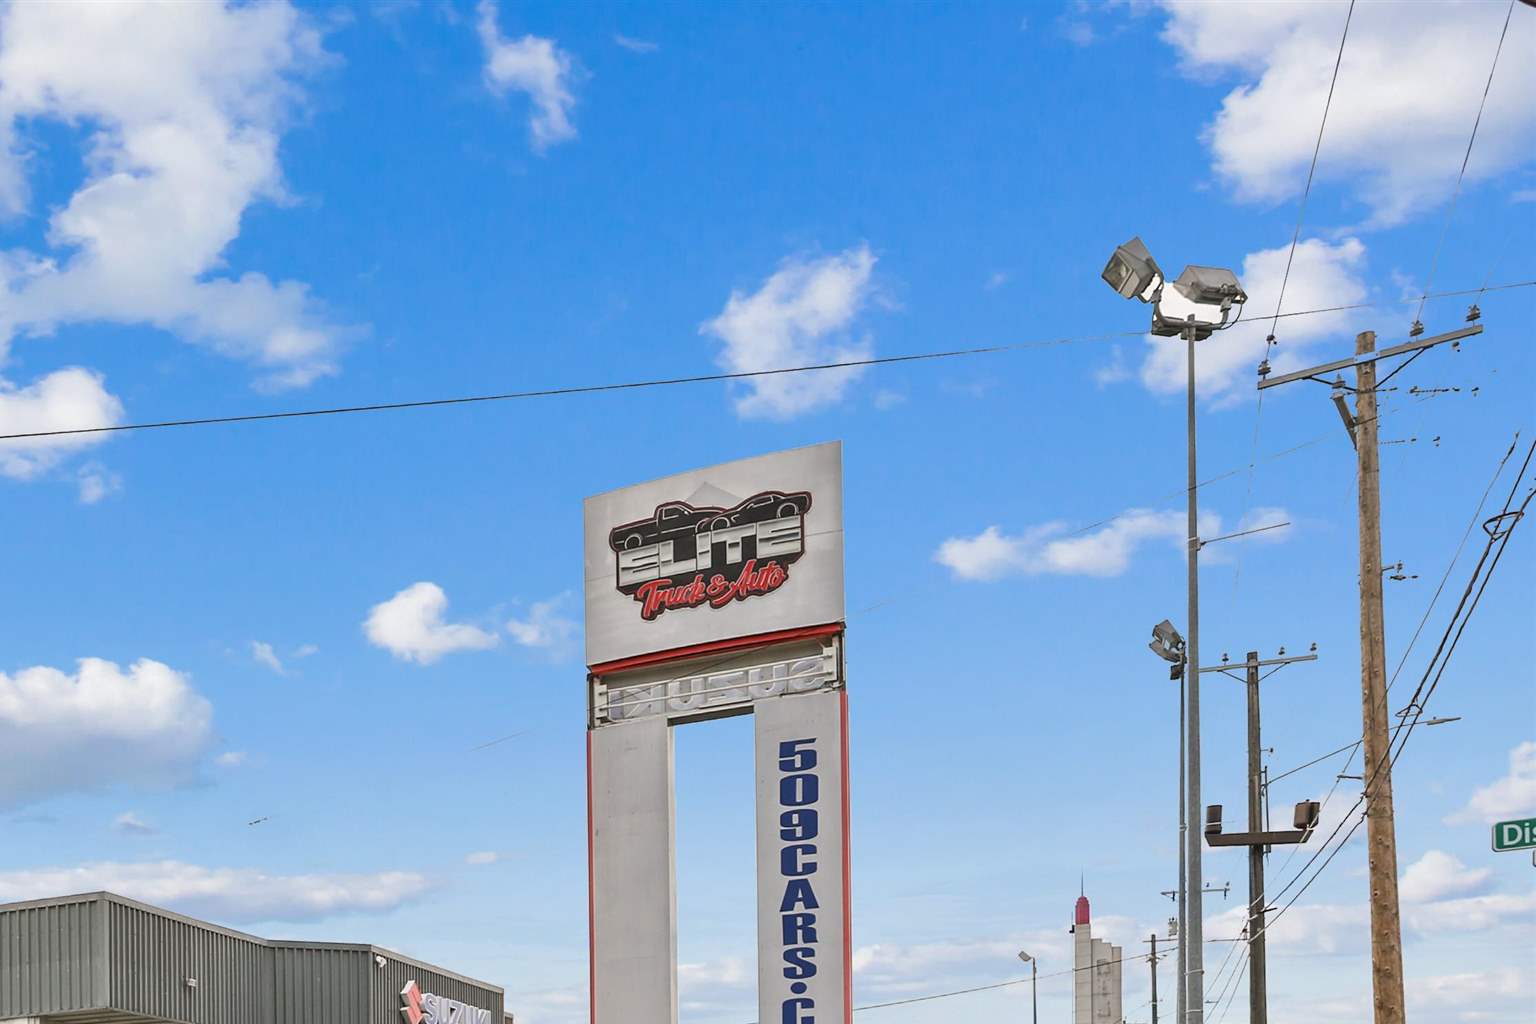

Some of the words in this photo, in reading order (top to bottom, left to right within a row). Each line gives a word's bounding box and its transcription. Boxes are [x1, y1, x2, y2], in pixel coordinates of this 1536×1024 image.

[617, 515, 802, 587] ELITE
[637, 574, 706, 619] Truck
[706, 574, 729, 597] &
[711, 559, 786, 605] Auto
